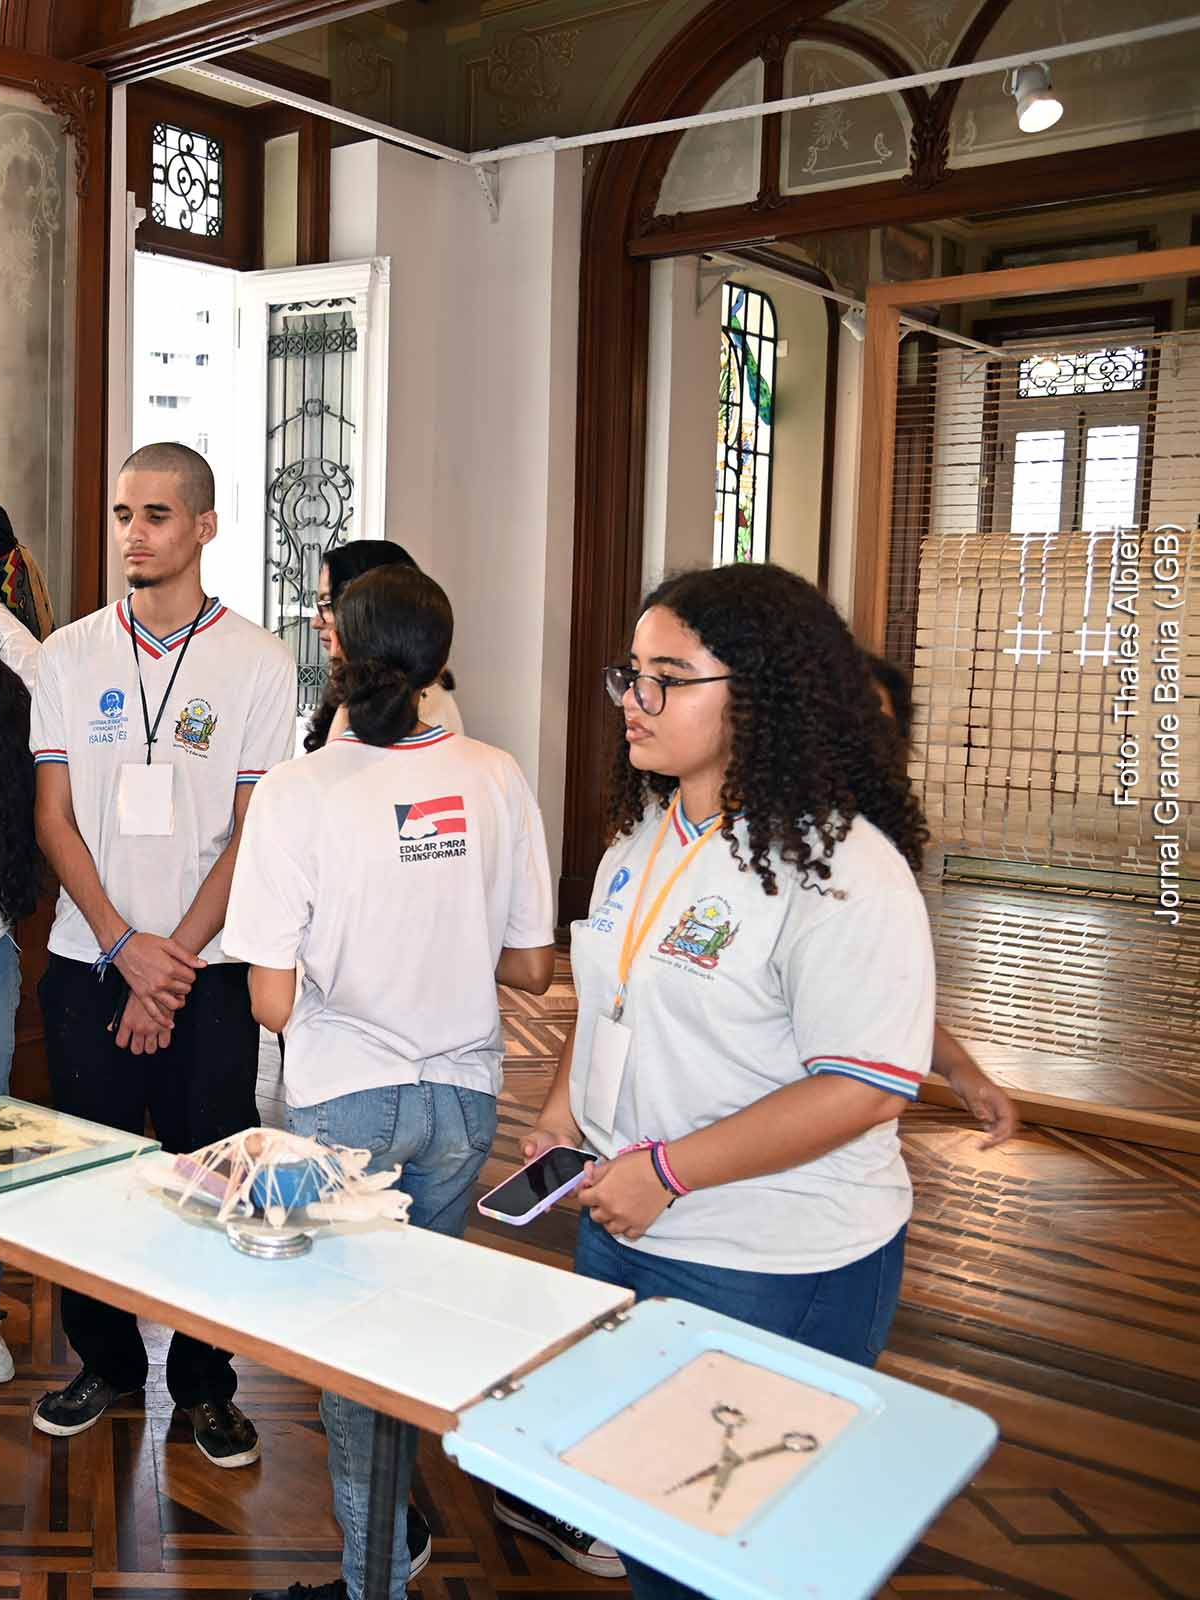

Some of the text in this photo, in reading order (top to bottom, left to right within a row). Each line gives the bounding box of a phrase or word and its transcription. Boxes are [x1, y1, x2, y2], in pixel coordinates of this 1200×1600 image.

[399, 839, 466, 855] EDUCAR PARA
[399, 848, 467, 863] TRANSFORMAR
